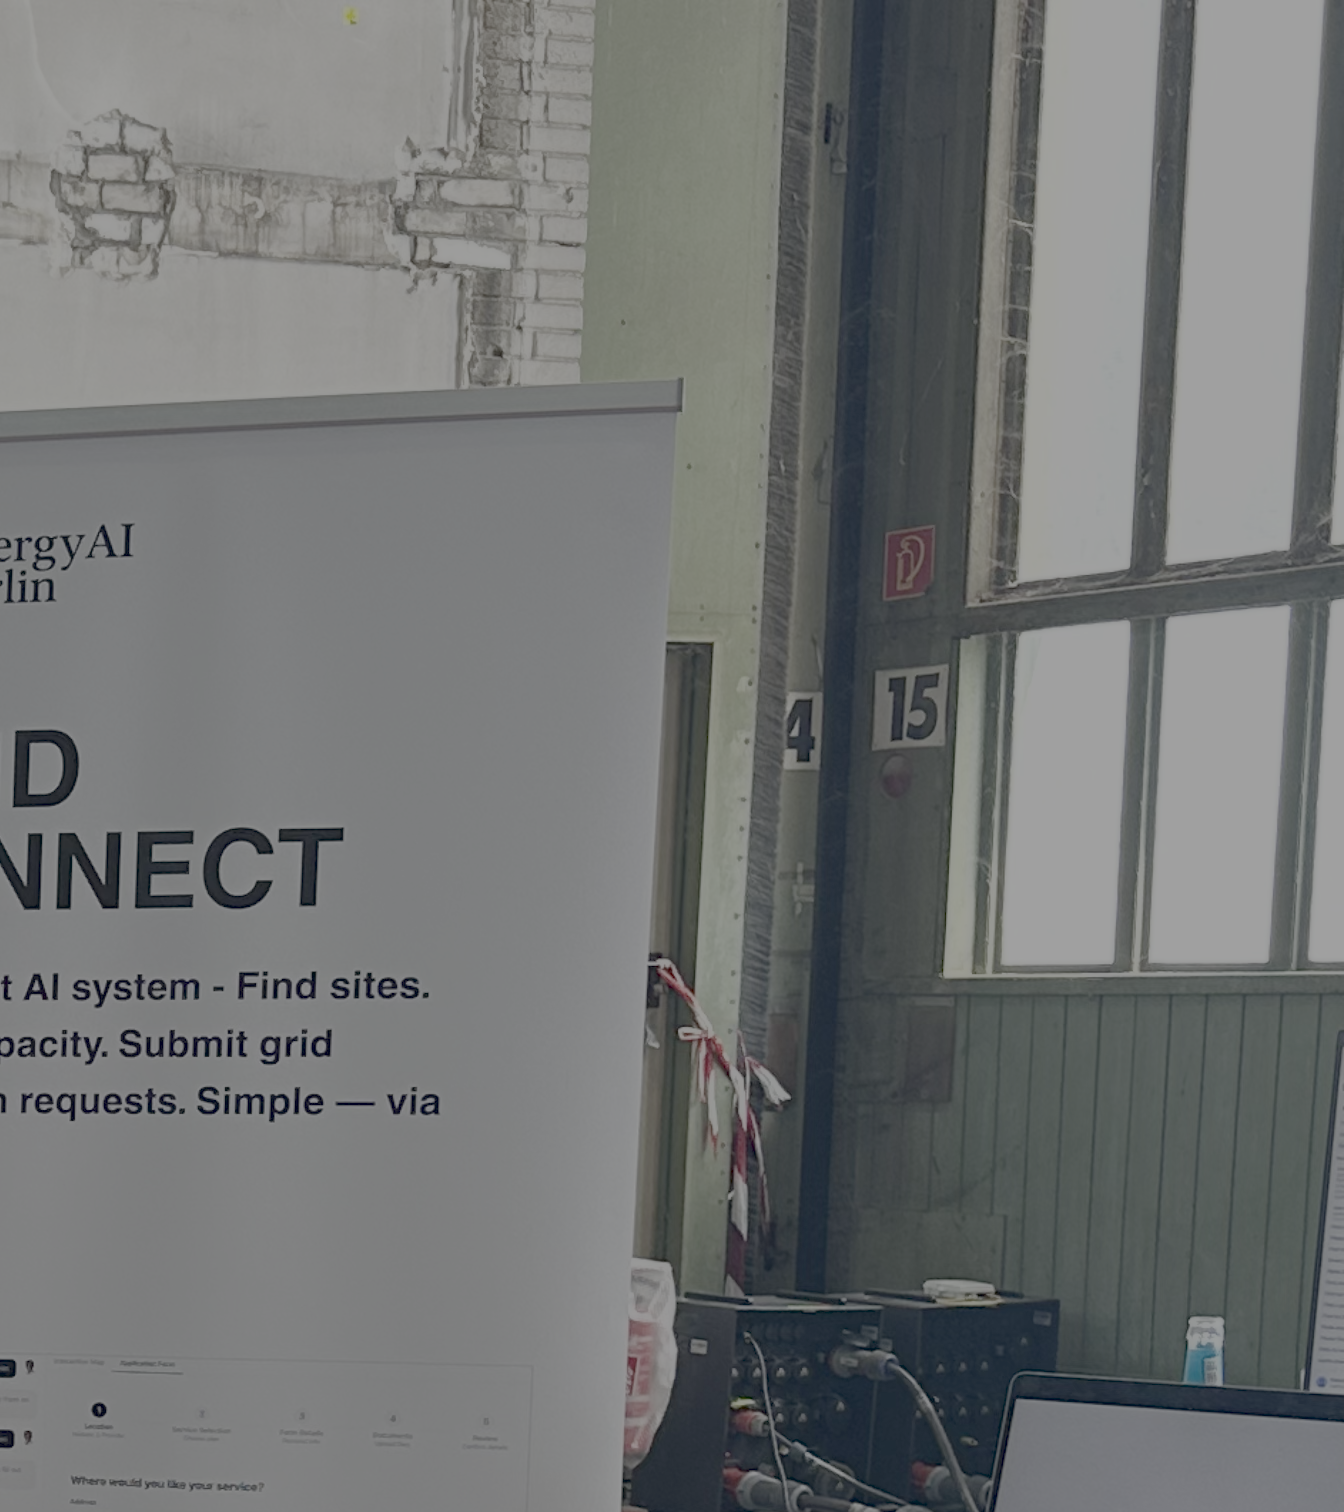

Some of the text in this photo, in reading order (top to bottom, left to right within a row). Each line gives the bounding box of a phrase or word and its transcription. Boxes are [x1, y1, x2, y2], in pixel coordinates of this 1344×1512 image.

[888, 673, 943, 742] 15
[24, 973, 58, 1000] AI
[72, 974, 199, 1008] system
[238, 971, 316, 999] Find
[331, 971, 429, 999] sites.
[119, 1030, 247, 1057] Submit
[261, 1029, 332, 1065] grid
[21, 1088, 185, 1121] requests.
[198, 1087, 323, 1122] Simple
[387, 1087, 439, 1115] via
[70, 1475, 265, 1492] Where would you like your service?
